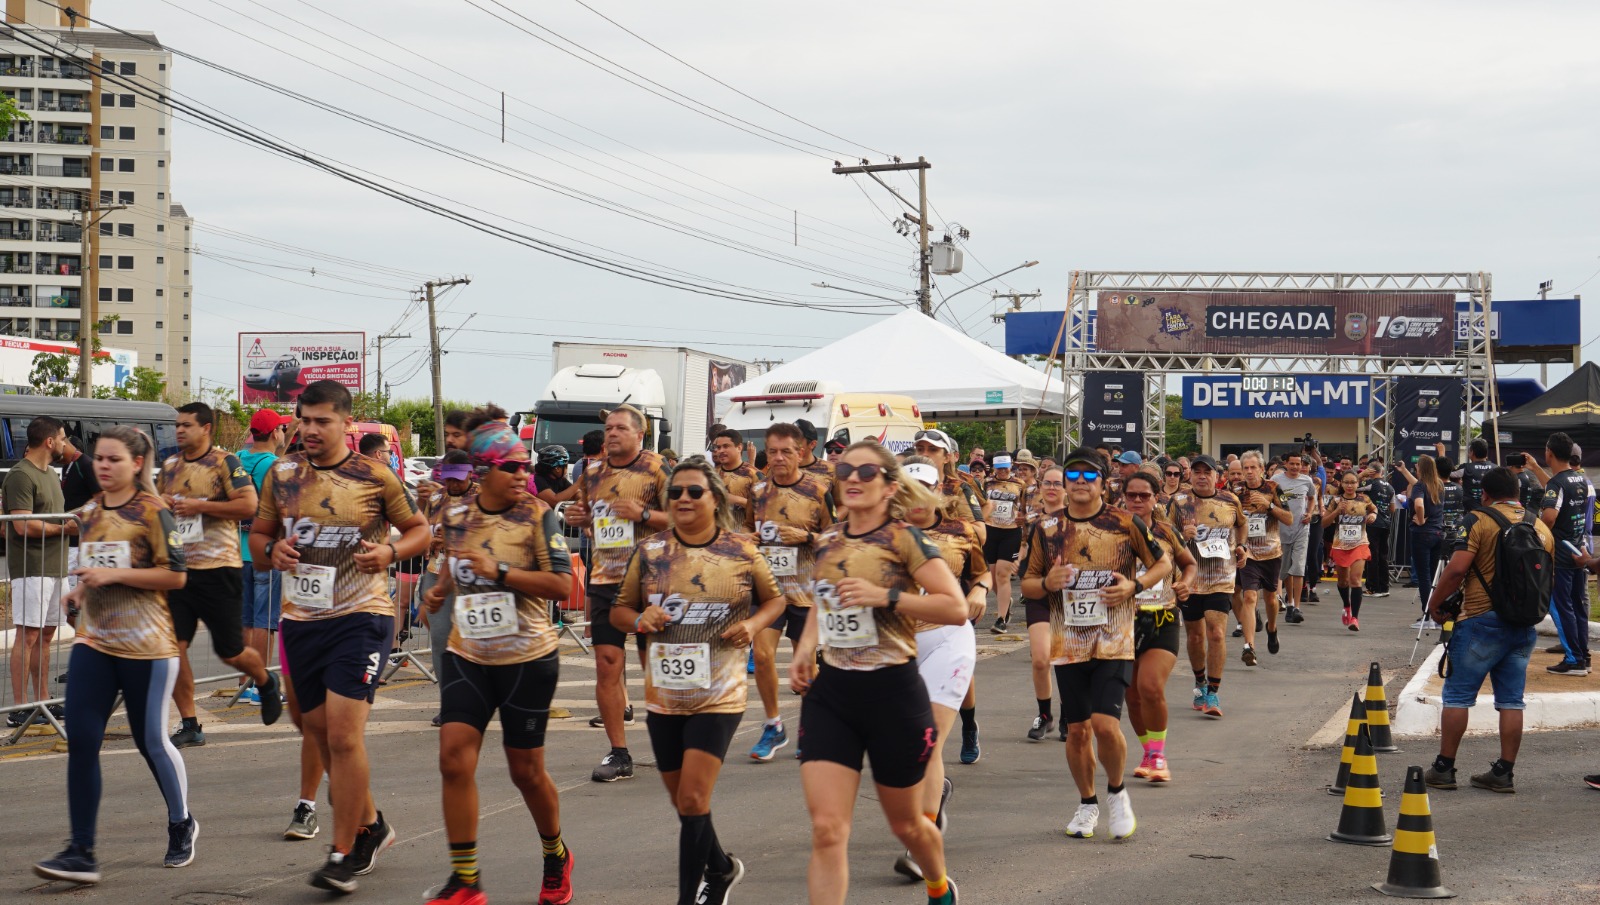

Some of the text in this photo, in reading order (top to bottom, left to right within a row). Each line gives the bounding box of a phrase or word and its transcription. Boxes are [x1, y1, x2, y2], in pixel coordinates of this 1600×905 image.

[1212, 312, 1330, 330] CHEGADA
[302, 350, 358, 363] INSPEÇÃO!
[1193, 380, 1369, 407] DETRAN-MT
[1254, 411, 1290, 419] GUARITA
[601, 526, 624, 538] 909
[766, 556, 789, 567] 543
[293, 576, 321, 595] 706
[467, 607, 502, 625] 616
[1071, 602, 1097, 615] 157
[661, 659, 695, 676] 639
